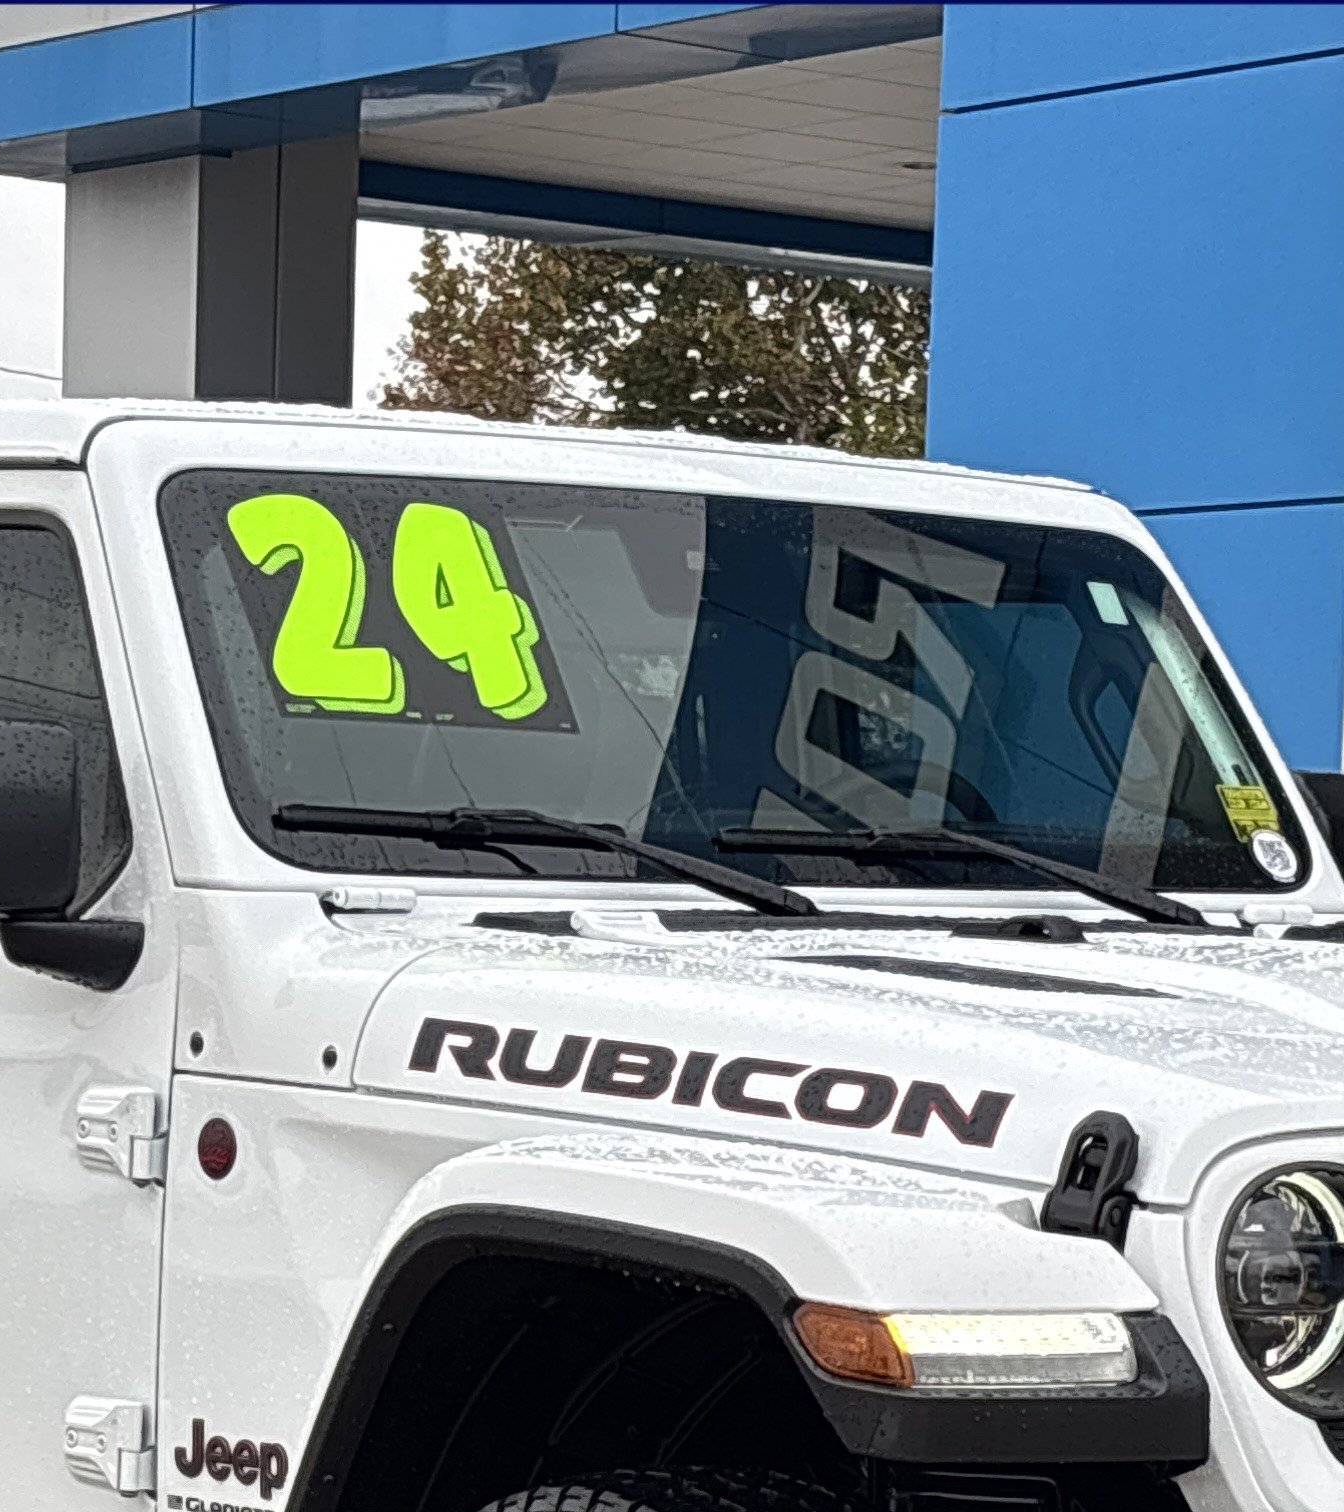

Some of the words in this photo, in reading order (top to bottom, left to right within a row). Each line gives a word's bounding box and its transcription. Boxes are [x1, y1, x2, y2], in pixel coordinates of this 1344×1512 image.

[227, 493, 548, 721] 24
[408, 1017, 1016, 1149] RUBICON
[174, 1418, 289, 1501] Jeep
